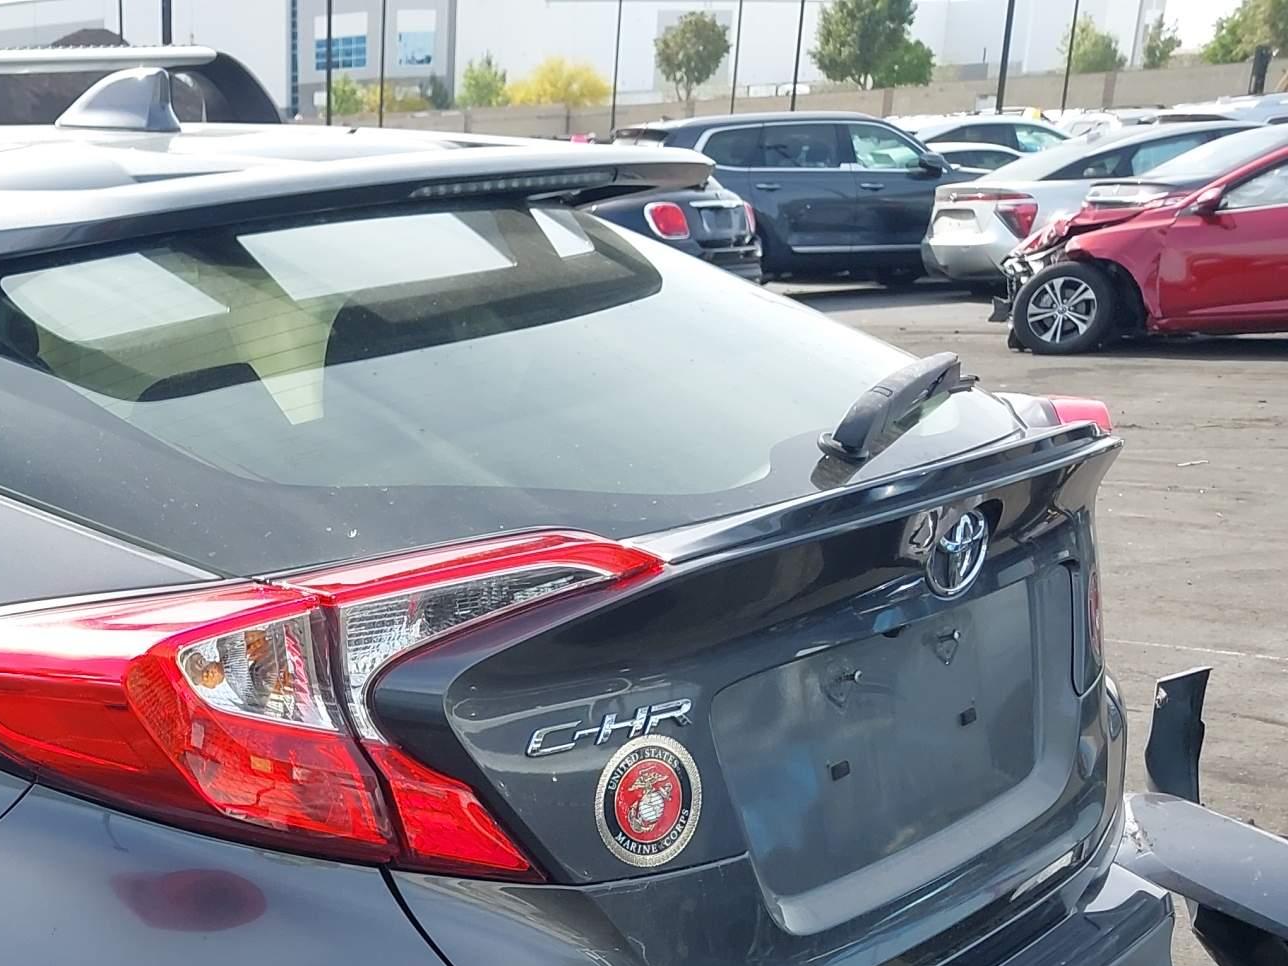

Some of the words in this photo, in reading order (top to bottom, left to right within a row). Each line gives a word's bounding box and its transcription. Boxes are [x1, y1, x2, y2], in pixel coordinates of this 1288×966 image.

[526, 699, 692, 757] C-HR
[608, 754, 640, 791] UNITED
[644, 748, 681, 769] STATES
[615, 832, 660, 855] MARINE
[663, 808, 690, 848] CORPS
